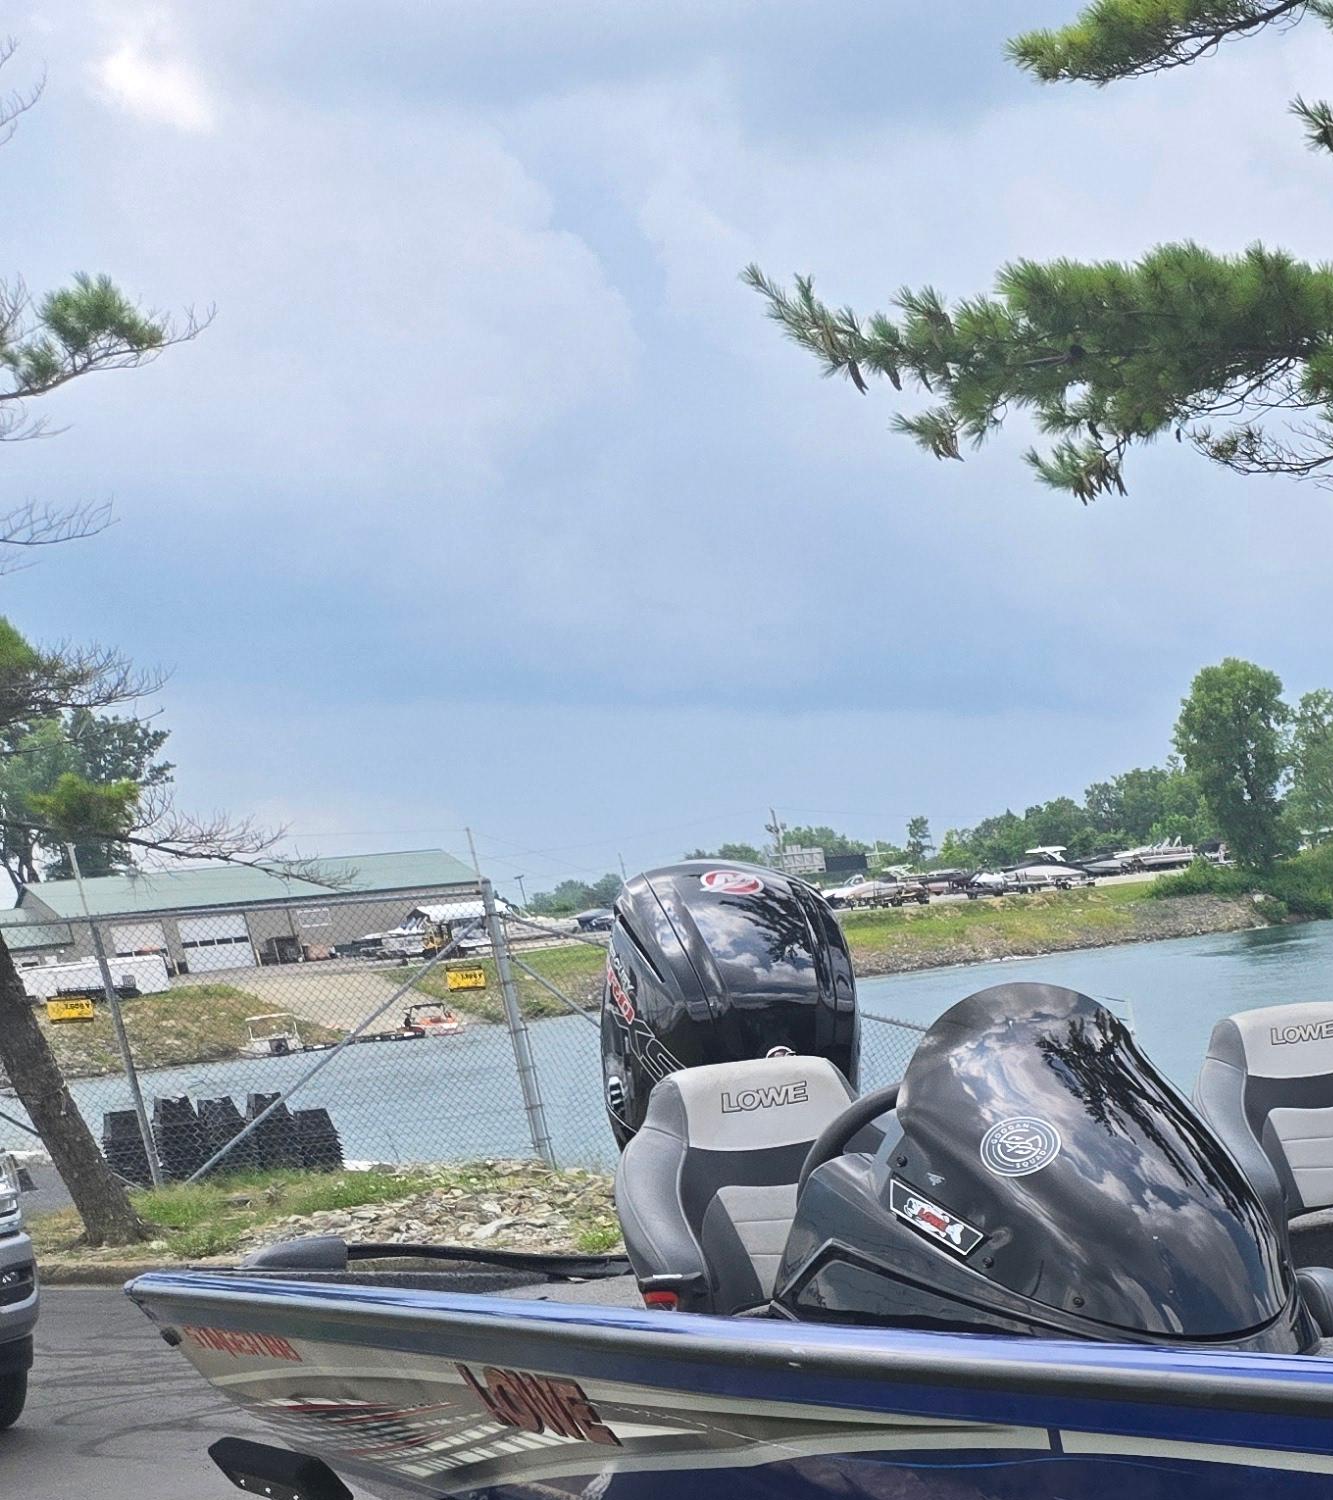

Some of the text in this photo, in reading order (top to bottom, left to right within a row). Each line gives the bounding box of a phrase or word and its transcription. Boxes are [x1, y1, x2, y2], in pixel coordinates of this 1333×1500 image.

[721, 1080, 810, 1114] LOWE
[991, 1123, 1030, 1144] GOOGAN
[1015, 1150, 1047, 1168] SQUAD
[454, 1361, 624, 1447] LOWE
